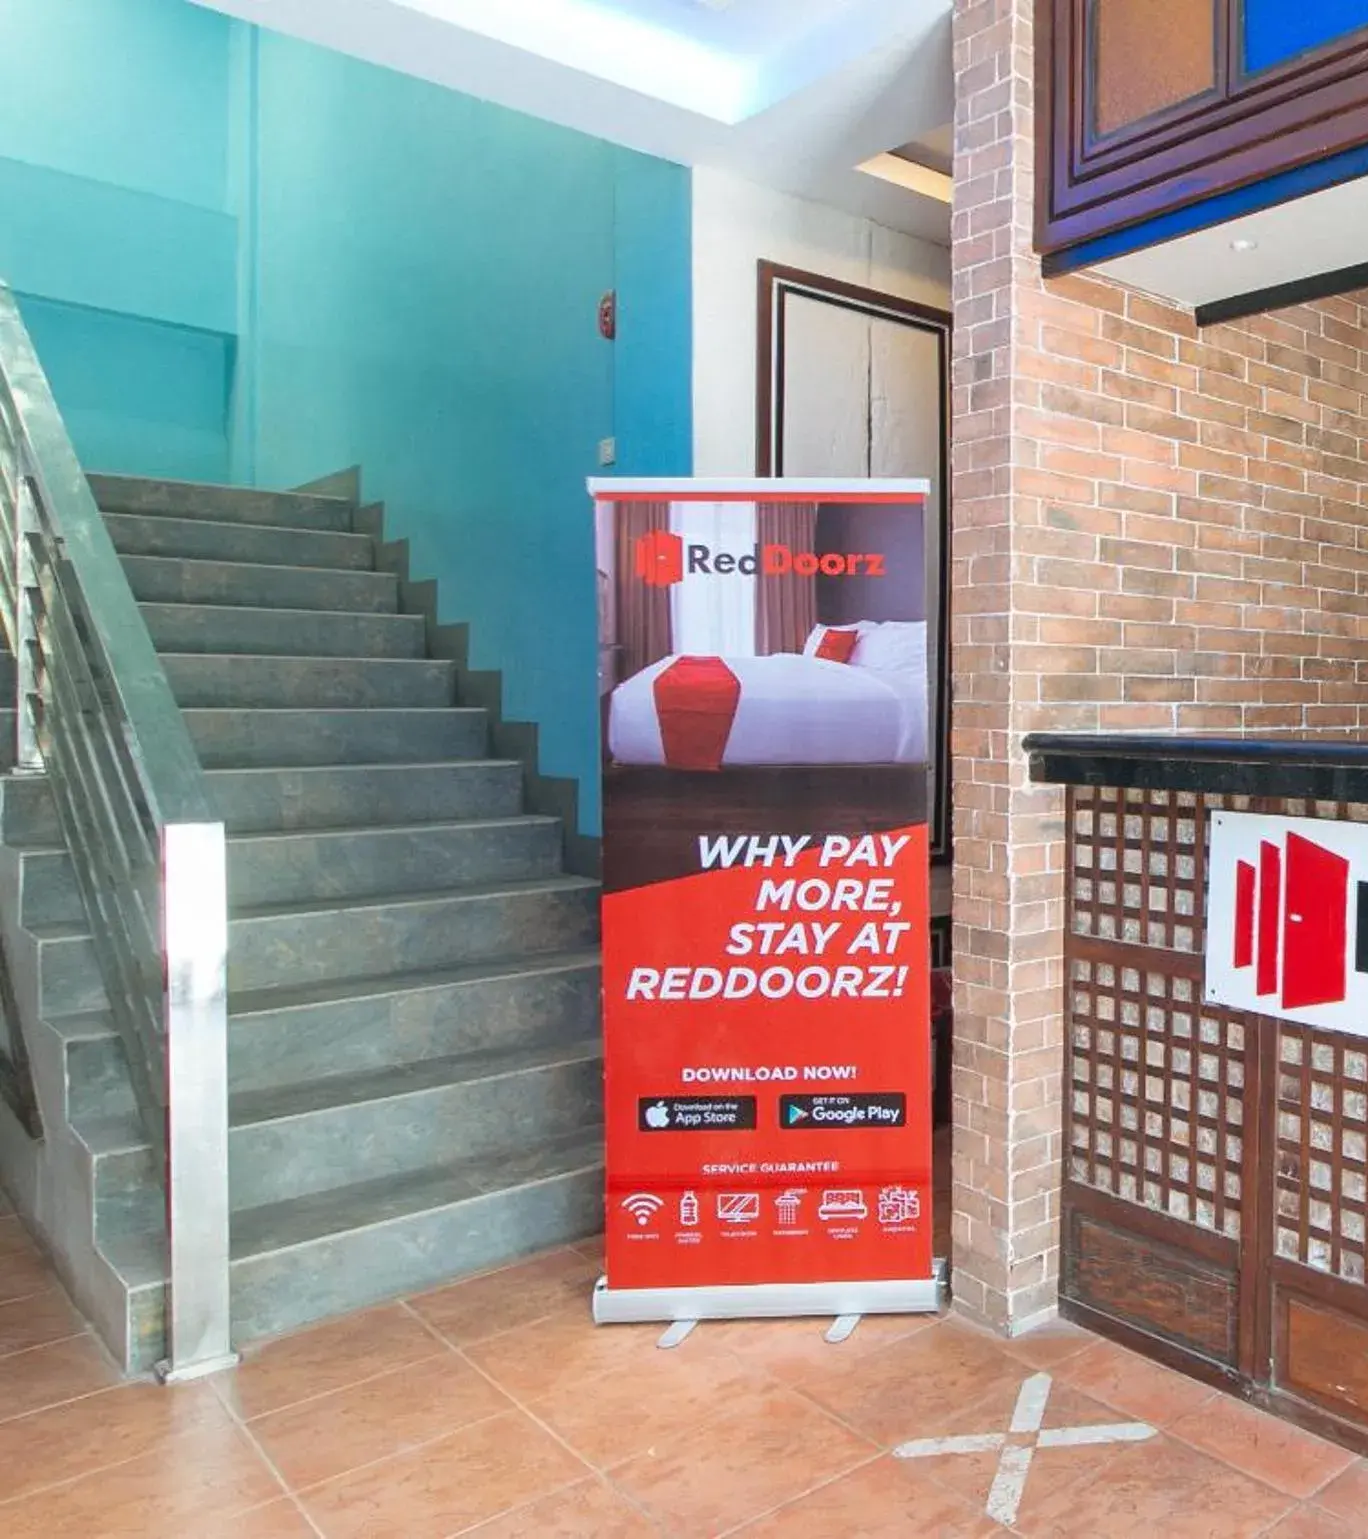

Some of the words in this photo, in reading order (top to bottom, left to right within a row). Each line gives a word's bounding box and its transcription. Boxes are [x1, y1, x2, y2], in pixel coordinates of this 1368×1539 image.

[687, 544, 887, 577] RedDoorz
[698, 834, 811, 869] WHY
[818, 834, 912, 868] PAY
[755, 878, 902, 917] MORE,
[725, 922, 842, 956] STAY
[846, 922, 912, 955] AT
[625, 965, 910, 1001] REDDOORZ!
[681, 1066, 798, 1083] DOWNLOAD
[803, 1065, 857, 1080] NOW!
[673, 1103, 712, 1112] Download
[674, 1112, 701, 1126] App
[703, 1111, 737, 1124] Store
[812, 1105, 865, 1124] Google
[868, 1105, 901, 1123] Play
[702, 1162, 757, 1175] SERVICE
[759, 1160, 840, 1174] GUARANTEE
